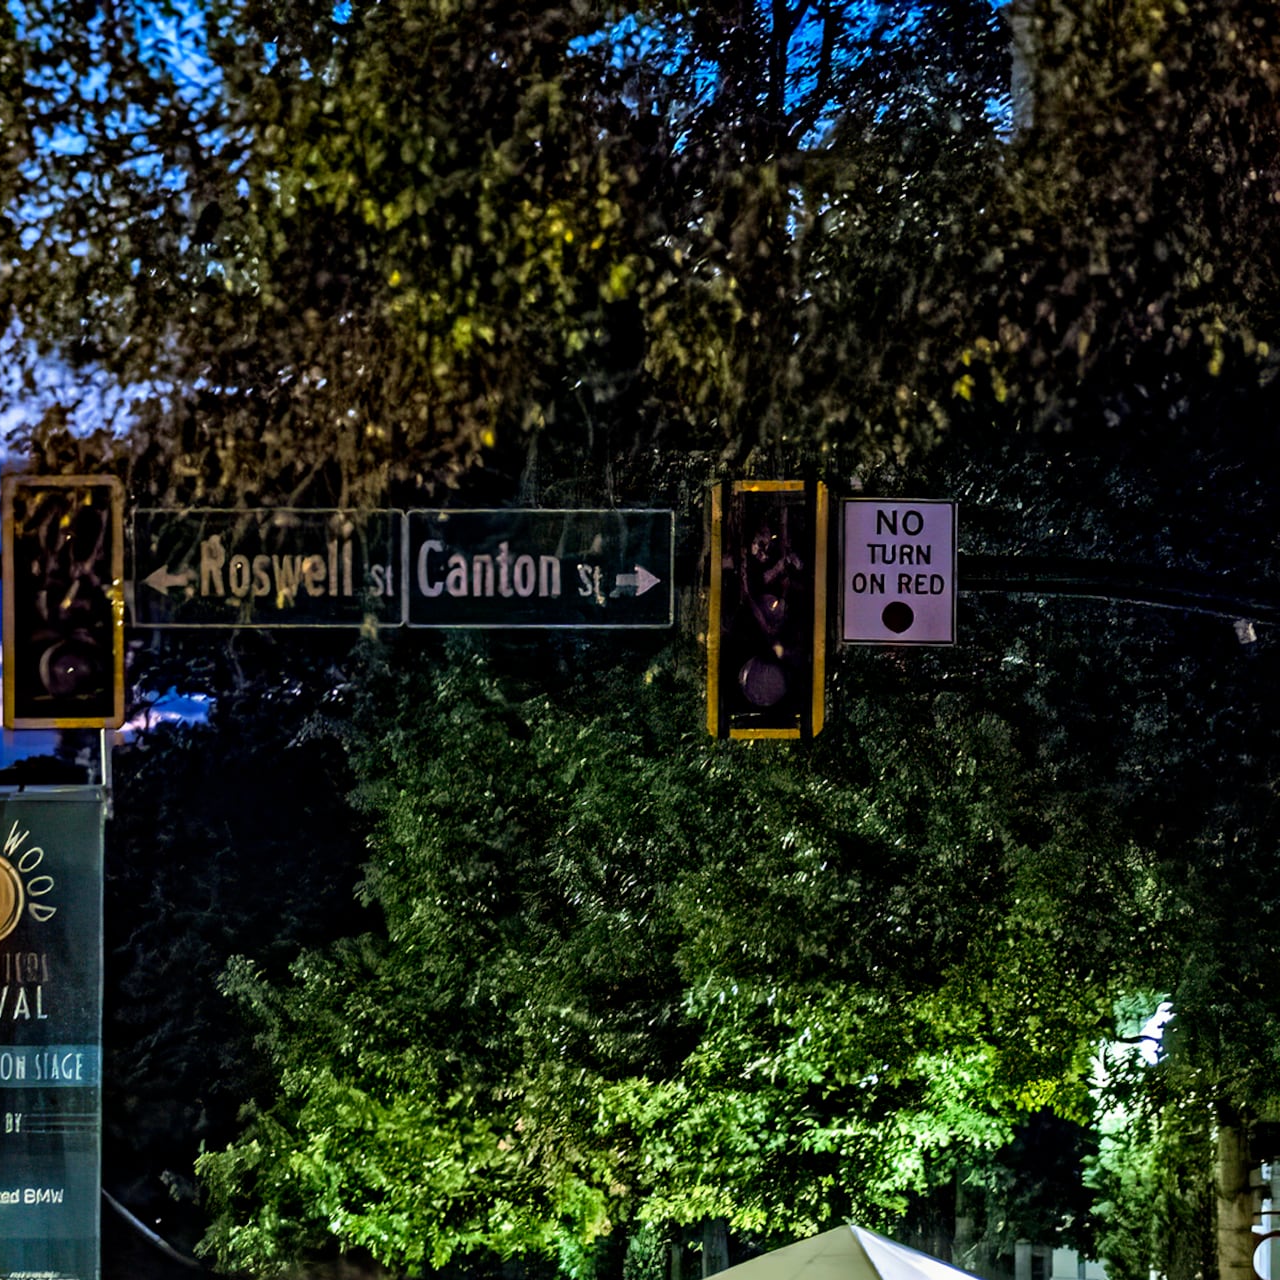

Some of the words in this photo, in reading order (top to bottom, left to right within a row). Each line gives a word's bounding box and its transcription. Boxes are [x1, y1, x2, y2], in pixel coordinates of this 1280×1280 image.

[876, 509, 924, 536] NO
[200, 534, 353, 597] Roswell
[866, 543, 931, 565] TURN
[417, 540, 561, 598] Canton
[852, 572, 885, 594] ON
[897, 573, 945, 595] RED
[3, 819, 58, 923] WOOD
[35, 1052, 84, 1080] STAGE
[5, 1112, 23, 1133] BY
[24, 1188, 64, 1204] BMW
